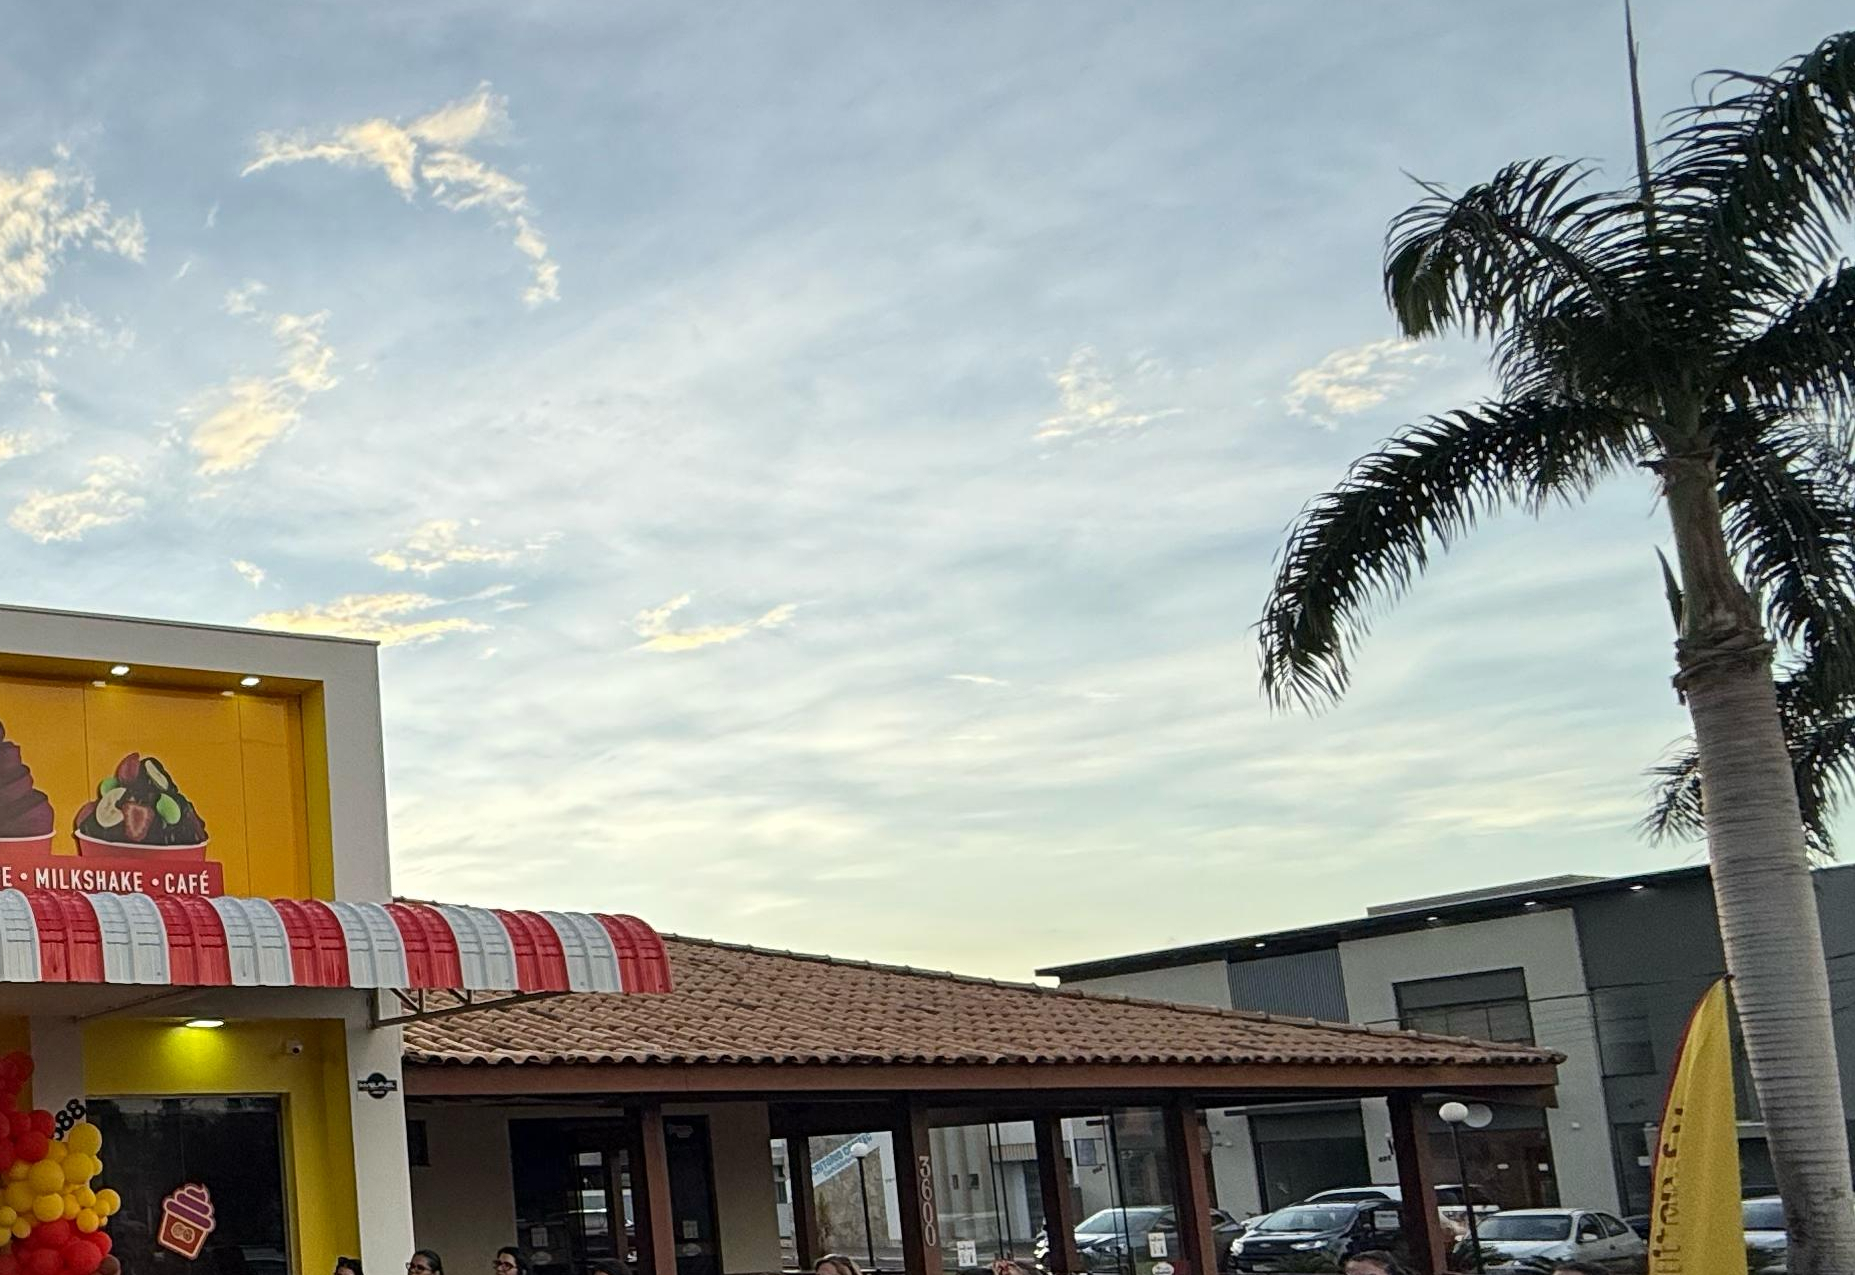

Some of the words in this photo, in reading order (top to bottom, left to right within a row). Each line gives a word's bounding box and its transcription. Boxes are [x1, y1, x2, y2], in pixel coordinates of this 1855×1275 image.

[35, 867, 143, 893] MILKSHAKE
[164, 869, 210, 895] CAFÉ
[919, 1156, 937, 1247] 3600
